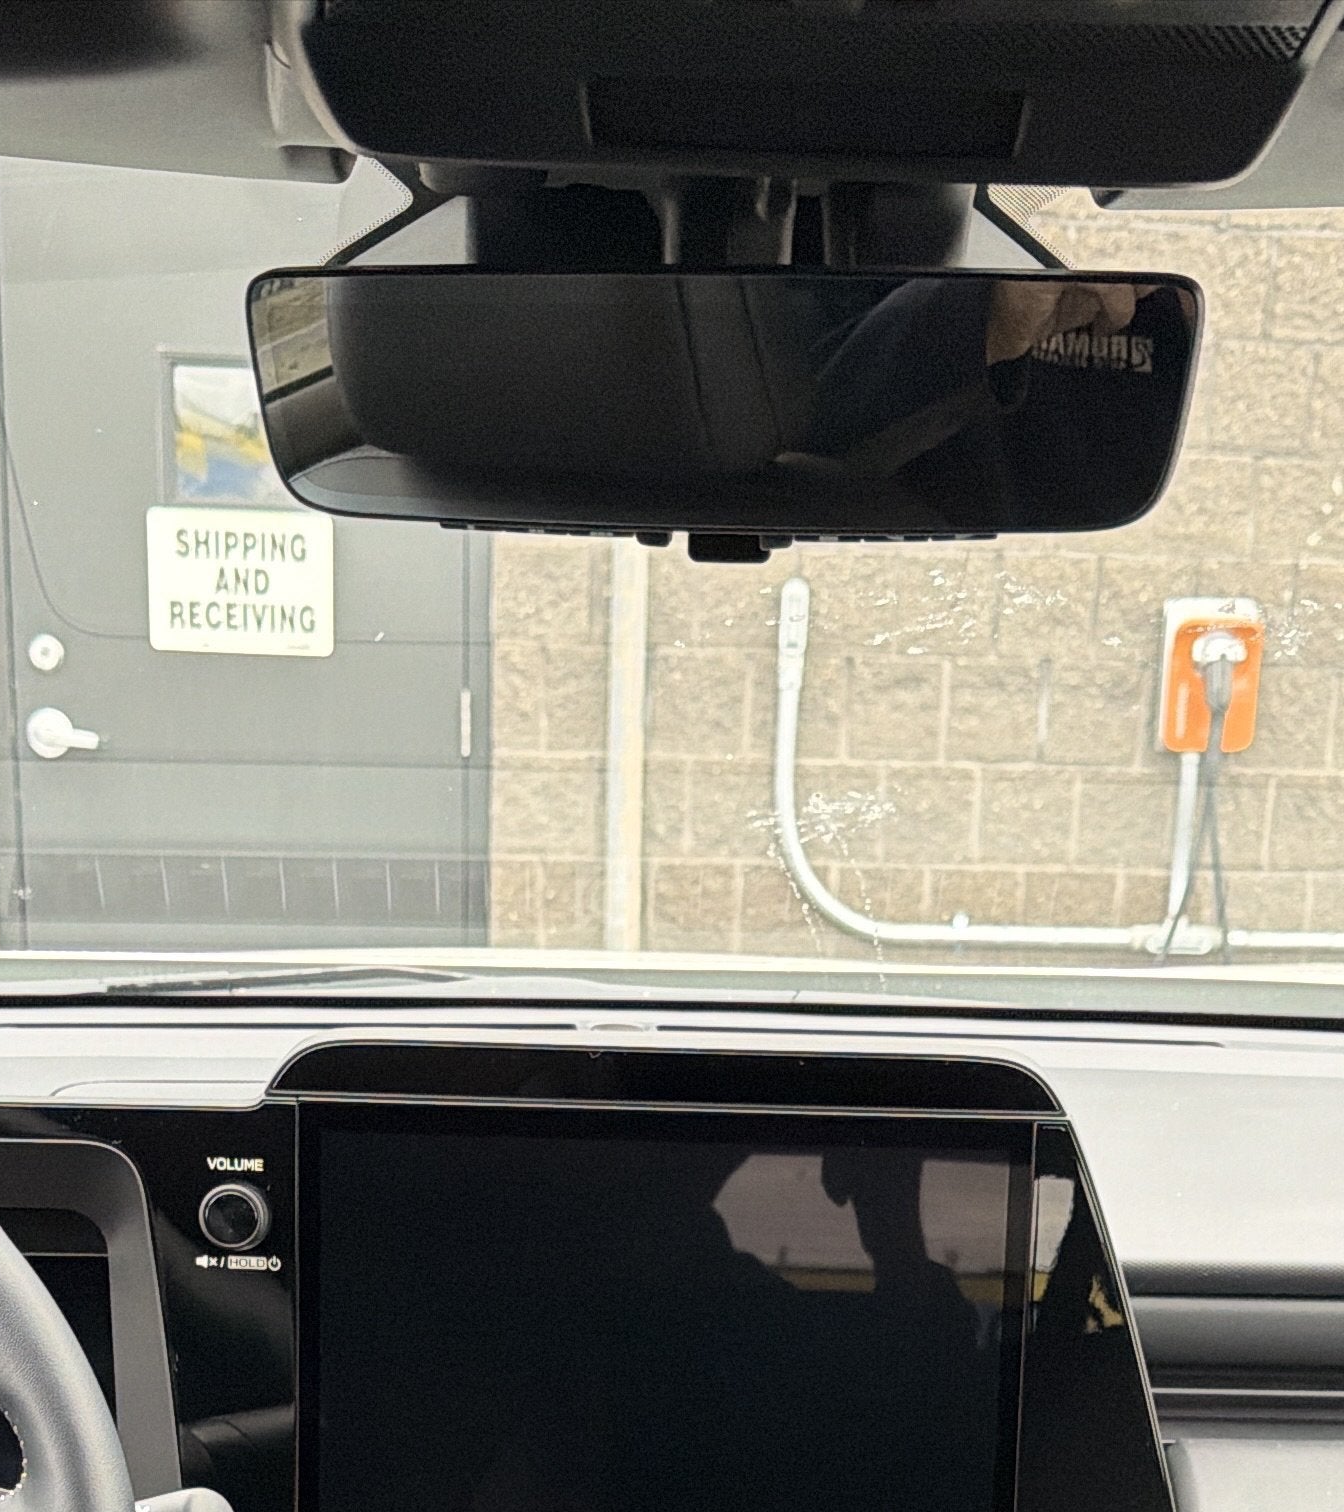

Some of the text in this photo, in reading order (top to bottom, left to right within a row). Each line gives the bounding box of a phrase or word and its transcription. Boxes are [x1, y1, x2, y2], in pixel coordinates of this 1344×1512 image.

[175, 528, 307, 562] SHIPPING
[214, 566, 270, 595] AND
[169, 600, 316, 633] RECEIVING
[206, 1156, 265, 1172] VOLUME
[229, 1258, 266, 1268] HOLD
